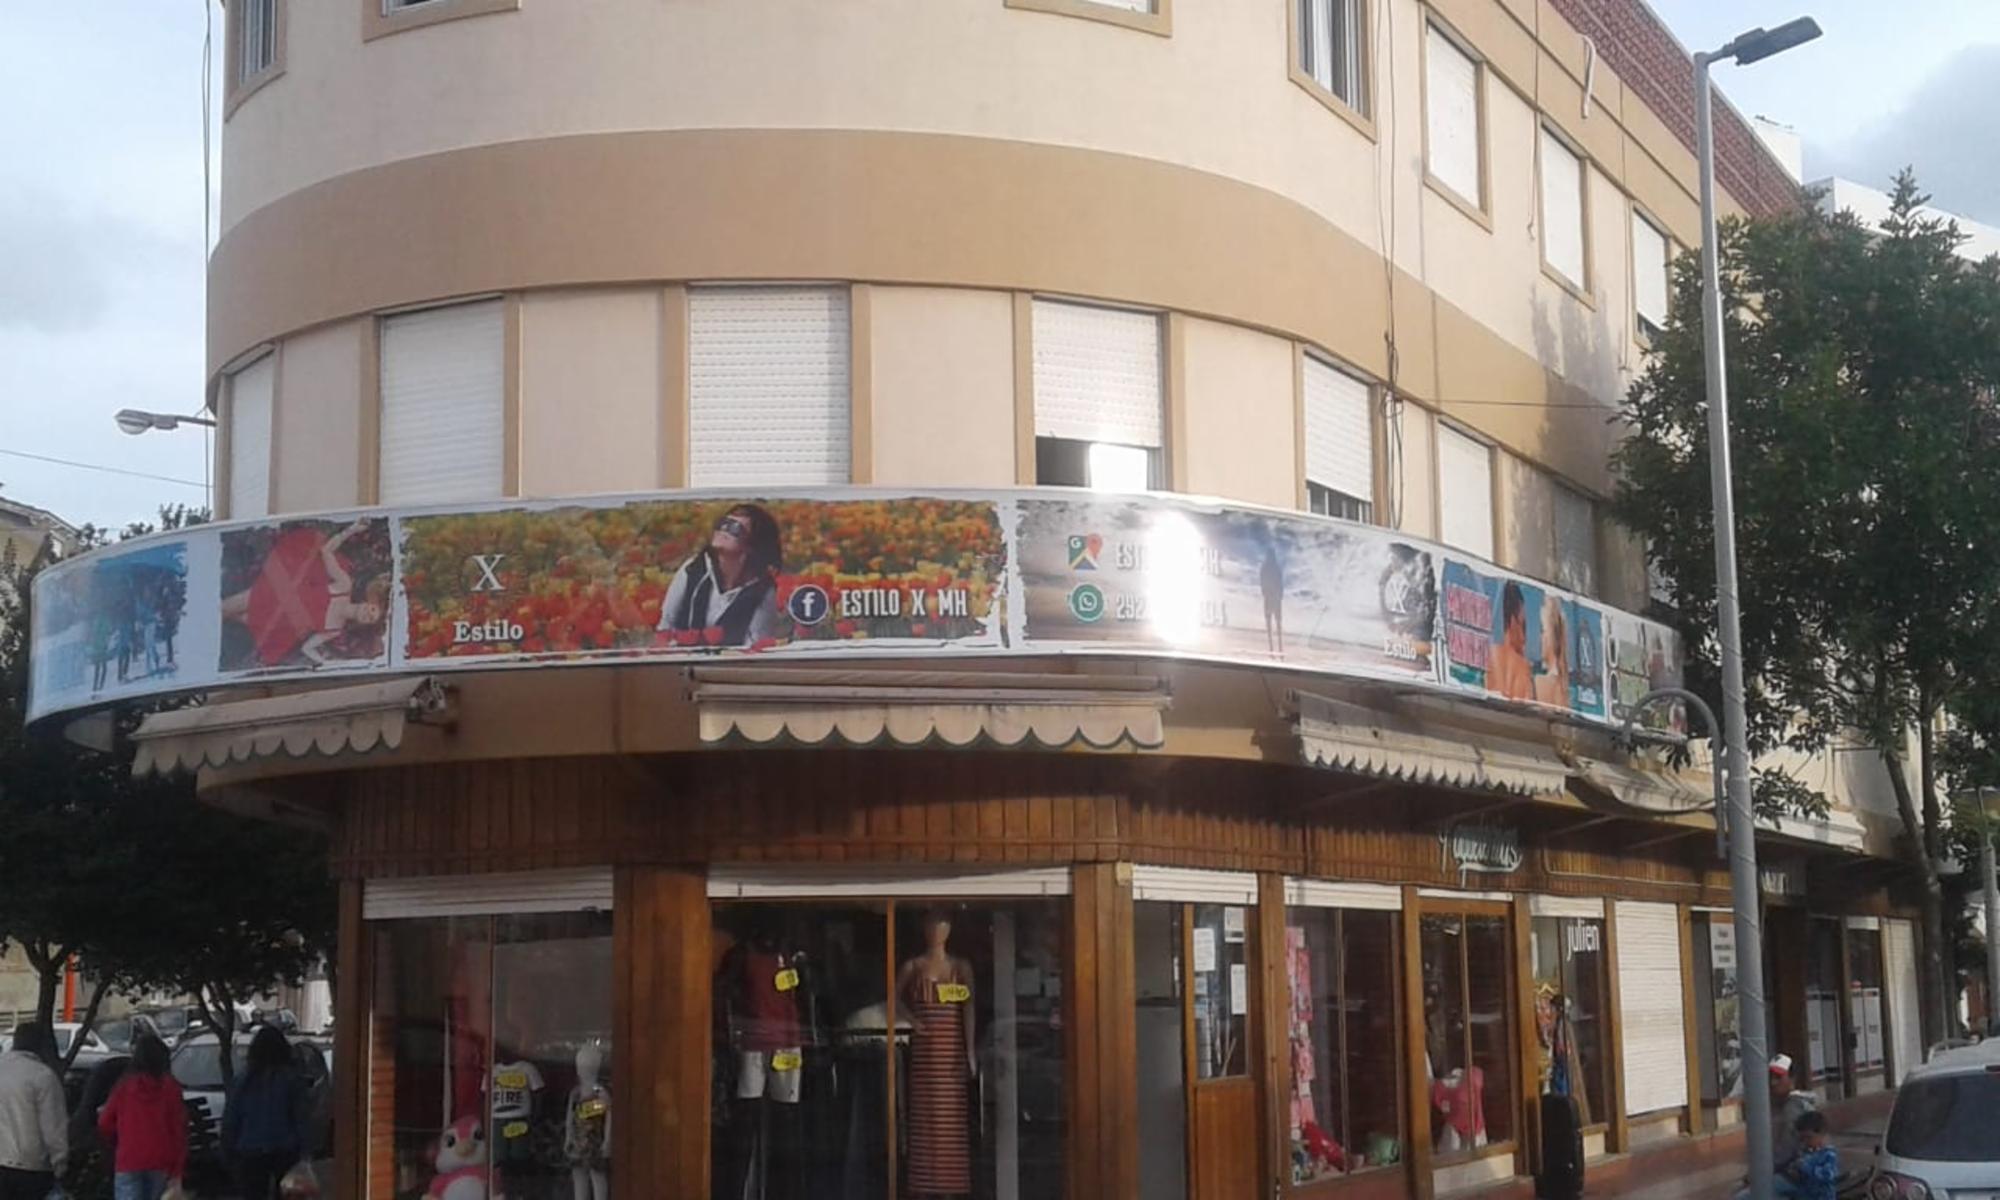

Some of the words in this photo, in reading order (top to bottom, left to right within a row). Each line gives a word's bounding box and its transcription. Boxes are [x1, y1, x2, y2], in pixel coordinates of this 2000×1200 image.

[471, 553, 506, 592] X
[841, 588, 900, 618] ESTILO
[911, 588, 926, 617] X
[938, 589, 968, 617] MH
[453, 619, 524, 643] Estilo
[1384, 636, 1418, 661] Estilo
